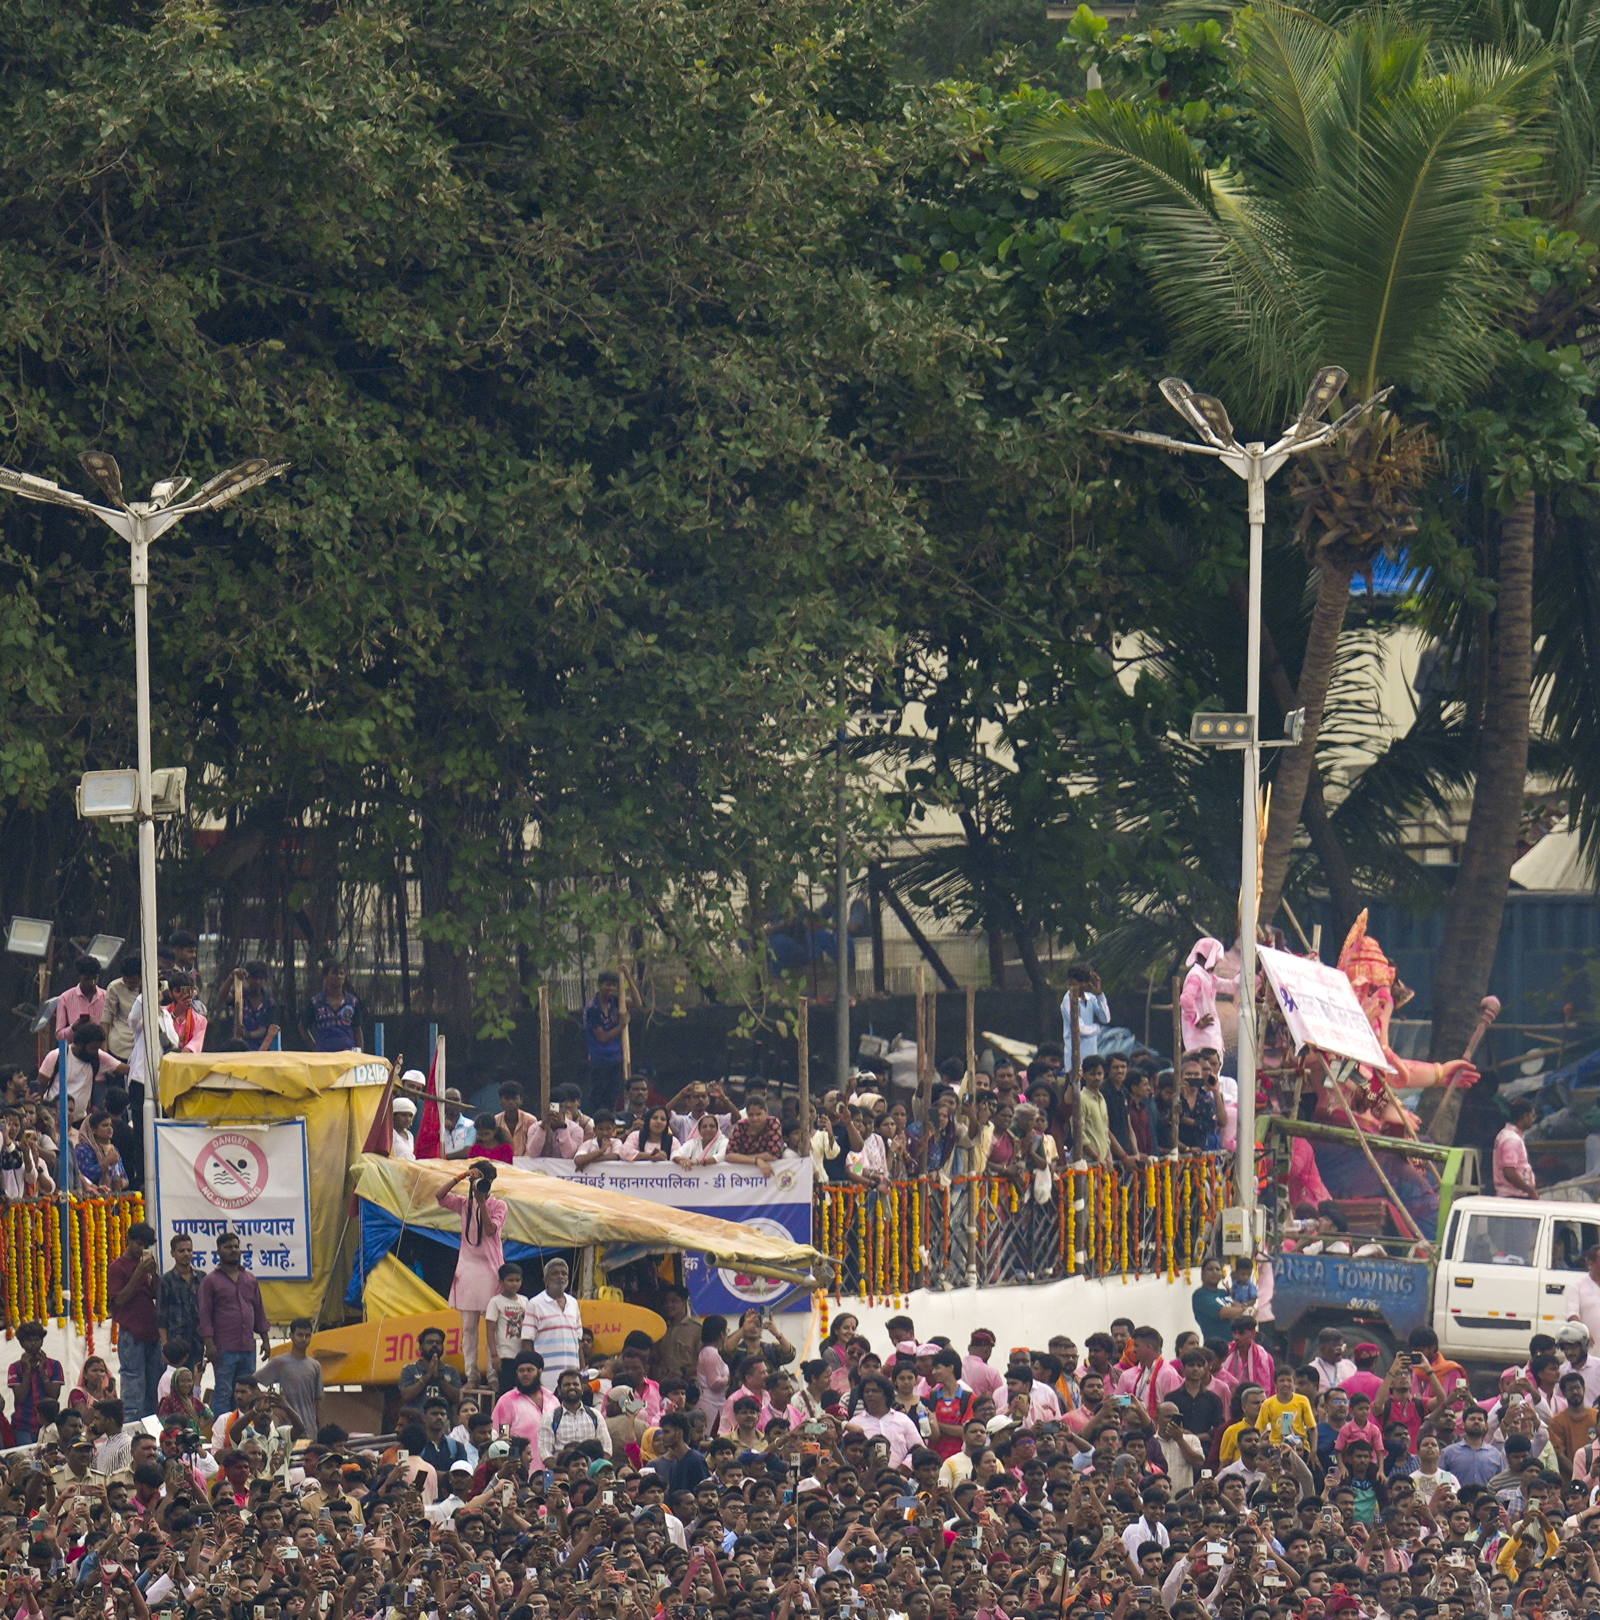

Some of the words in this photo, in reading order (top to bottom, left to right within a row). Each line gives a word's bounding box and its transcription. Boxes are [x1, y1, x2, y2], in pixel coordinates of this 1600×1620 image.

[212, 1135, 250, 1149] DANGER
[608, 1173, 701, 1190] महानगरपालिका
[201, 1186, 214, 1201] NO
[214, 1186, 262, 1209] SWIMMING
[172, 1218, 228, 1237] पाण्यात
[231, 1217, 295, 1237] जाण्यास
[258, 1242, 295, 1272] आहे.
[1334, 1263, 1414, 1295] TOWING
